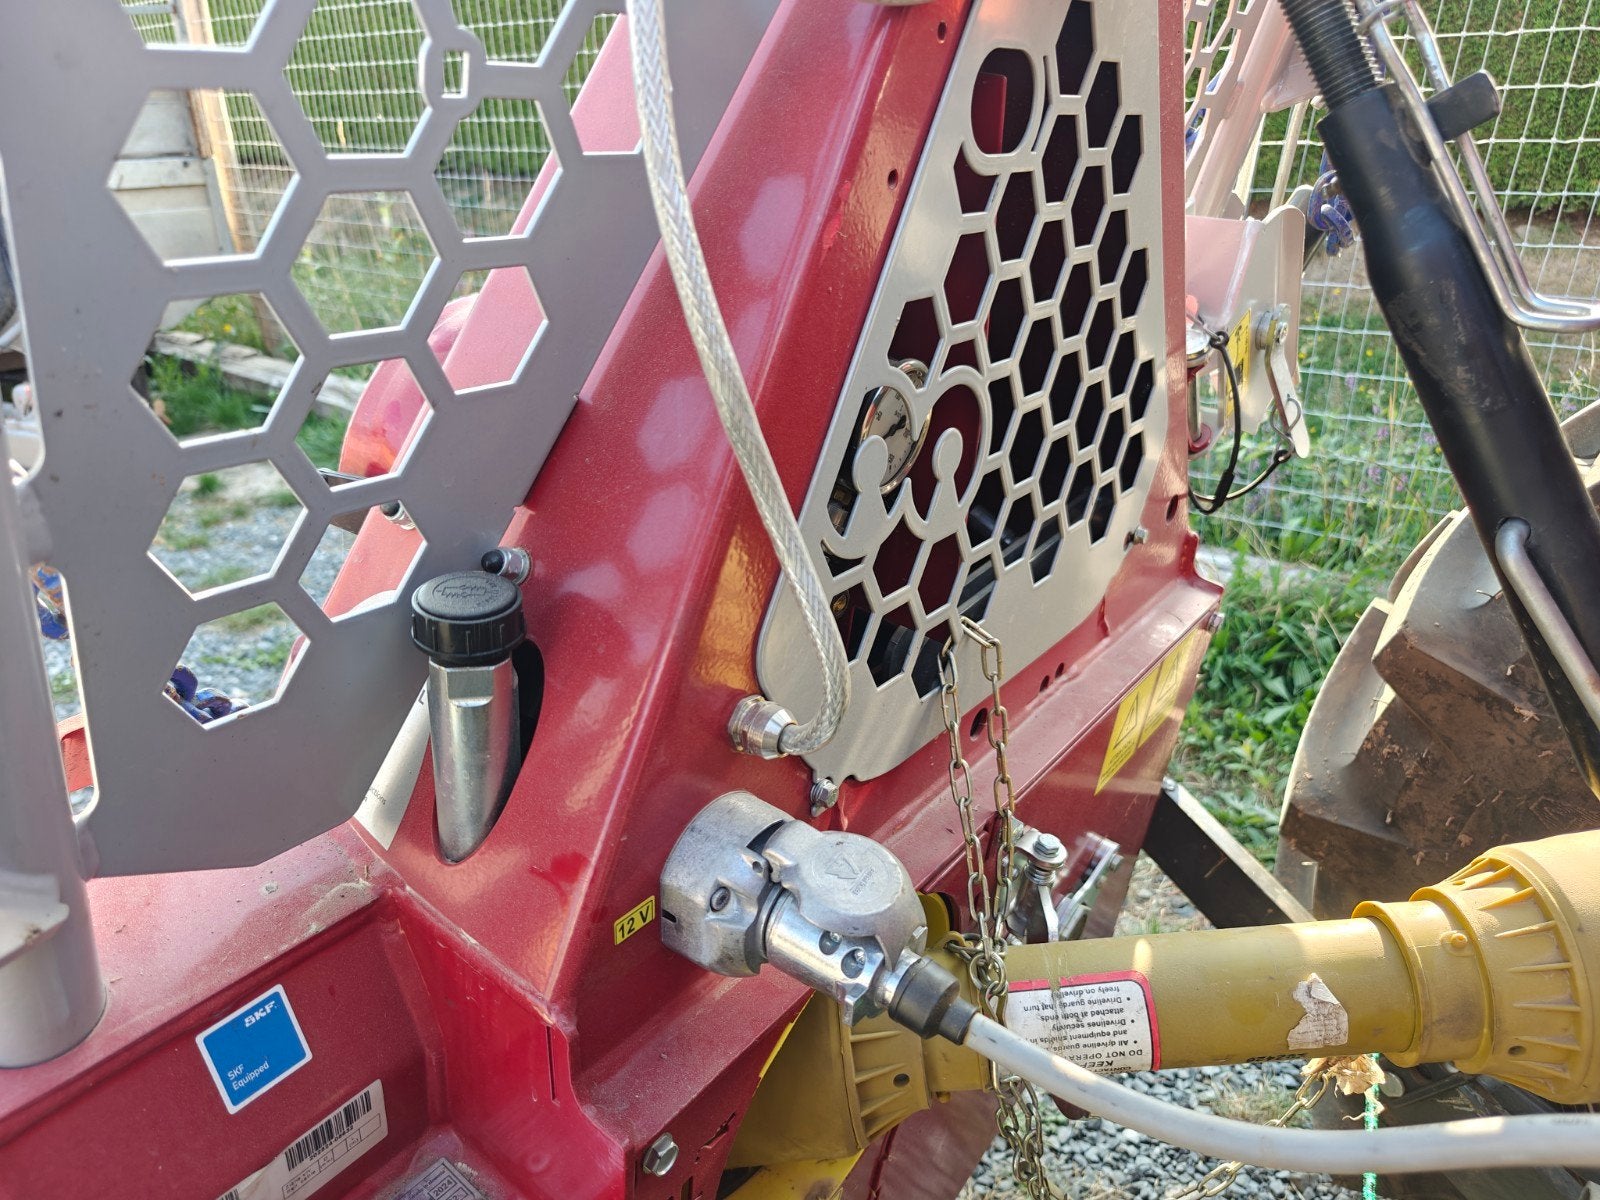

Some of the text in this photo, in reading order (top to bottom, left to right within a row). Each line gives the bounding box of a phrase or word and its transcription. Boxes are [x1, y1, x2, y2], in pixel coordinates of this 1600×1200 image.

[618, 904, 650, 939] 12 V
[1097, 985, 1120, 994] freely
[1087, 996, 1123, 1005] Driveline
[244, 1000, 276, 1028] SKF
[1061, 1011, 1079, 1020] both
[1090, 1007, 1125, 1016] attached
[1040, 1014, 1059, 1022] ends
[1087, 1018, 1127, 1028] Drivelines
[1069, 1031, 1111, 1041] equipment
[1112, 1029, 1128, 1037] and
[1082, 1040, 1116, 1049] driveline
[227, 1063, 245, 1081] SKF
[231, 1060, 270, 1091] Equipped
[432, 1179, 453, 1197] 2024
